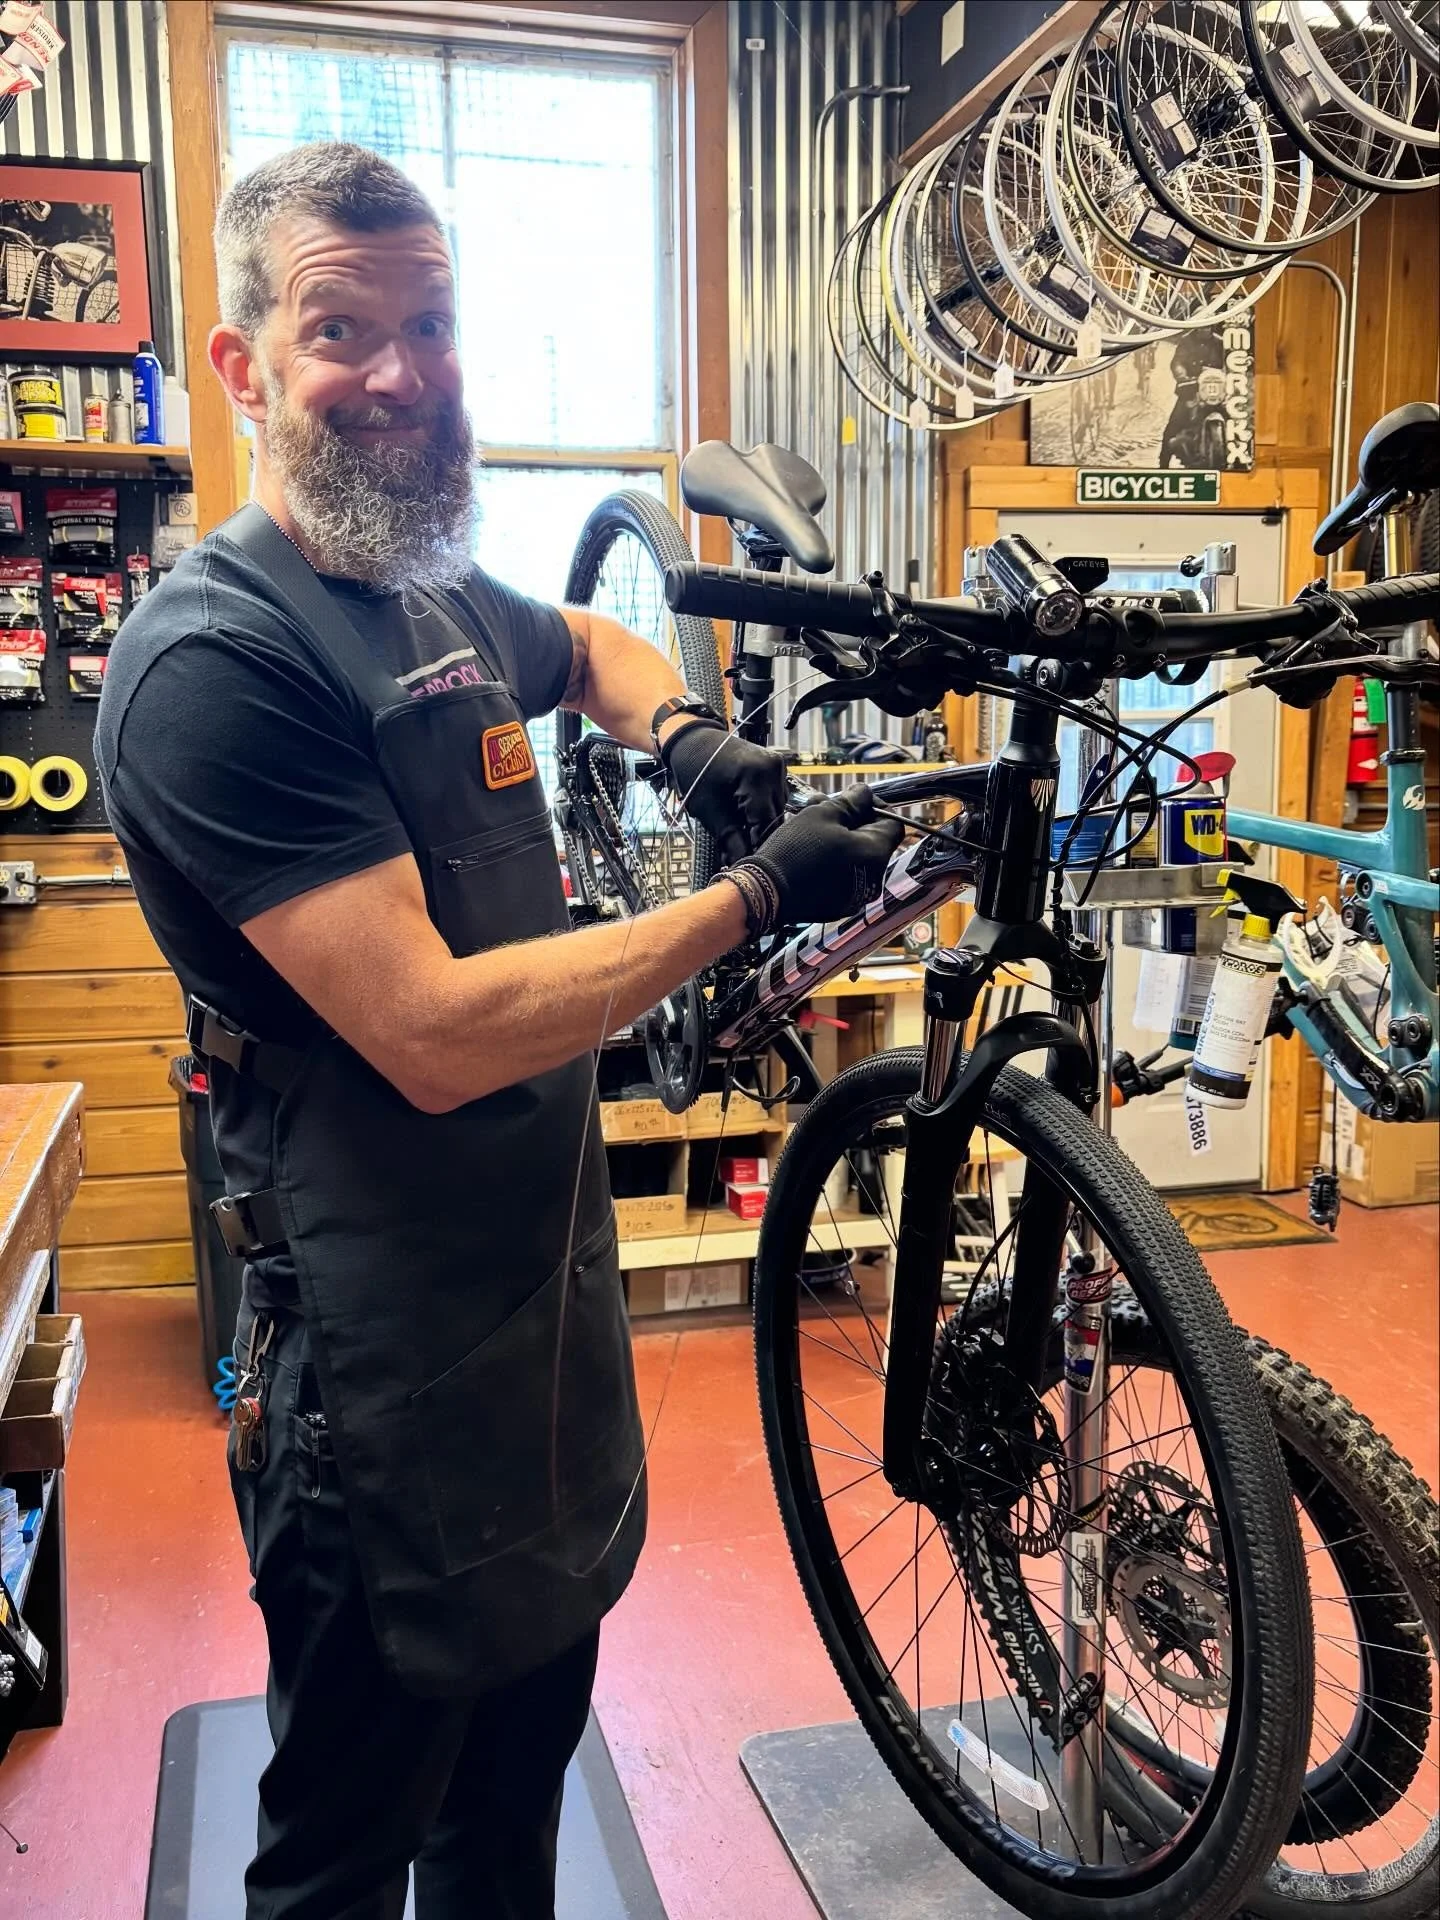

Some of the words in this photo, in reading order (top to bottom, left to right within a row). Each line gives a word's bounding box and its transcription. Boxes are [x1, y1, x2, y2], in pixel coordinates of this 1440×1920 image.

[1084, 476, 1196, 499] BICYCLE
[98, 517, 114, 526] TAPE
[1072, 560, 1105, 568] CATEYE
[492, 743, 529, 778] CYCLIST
